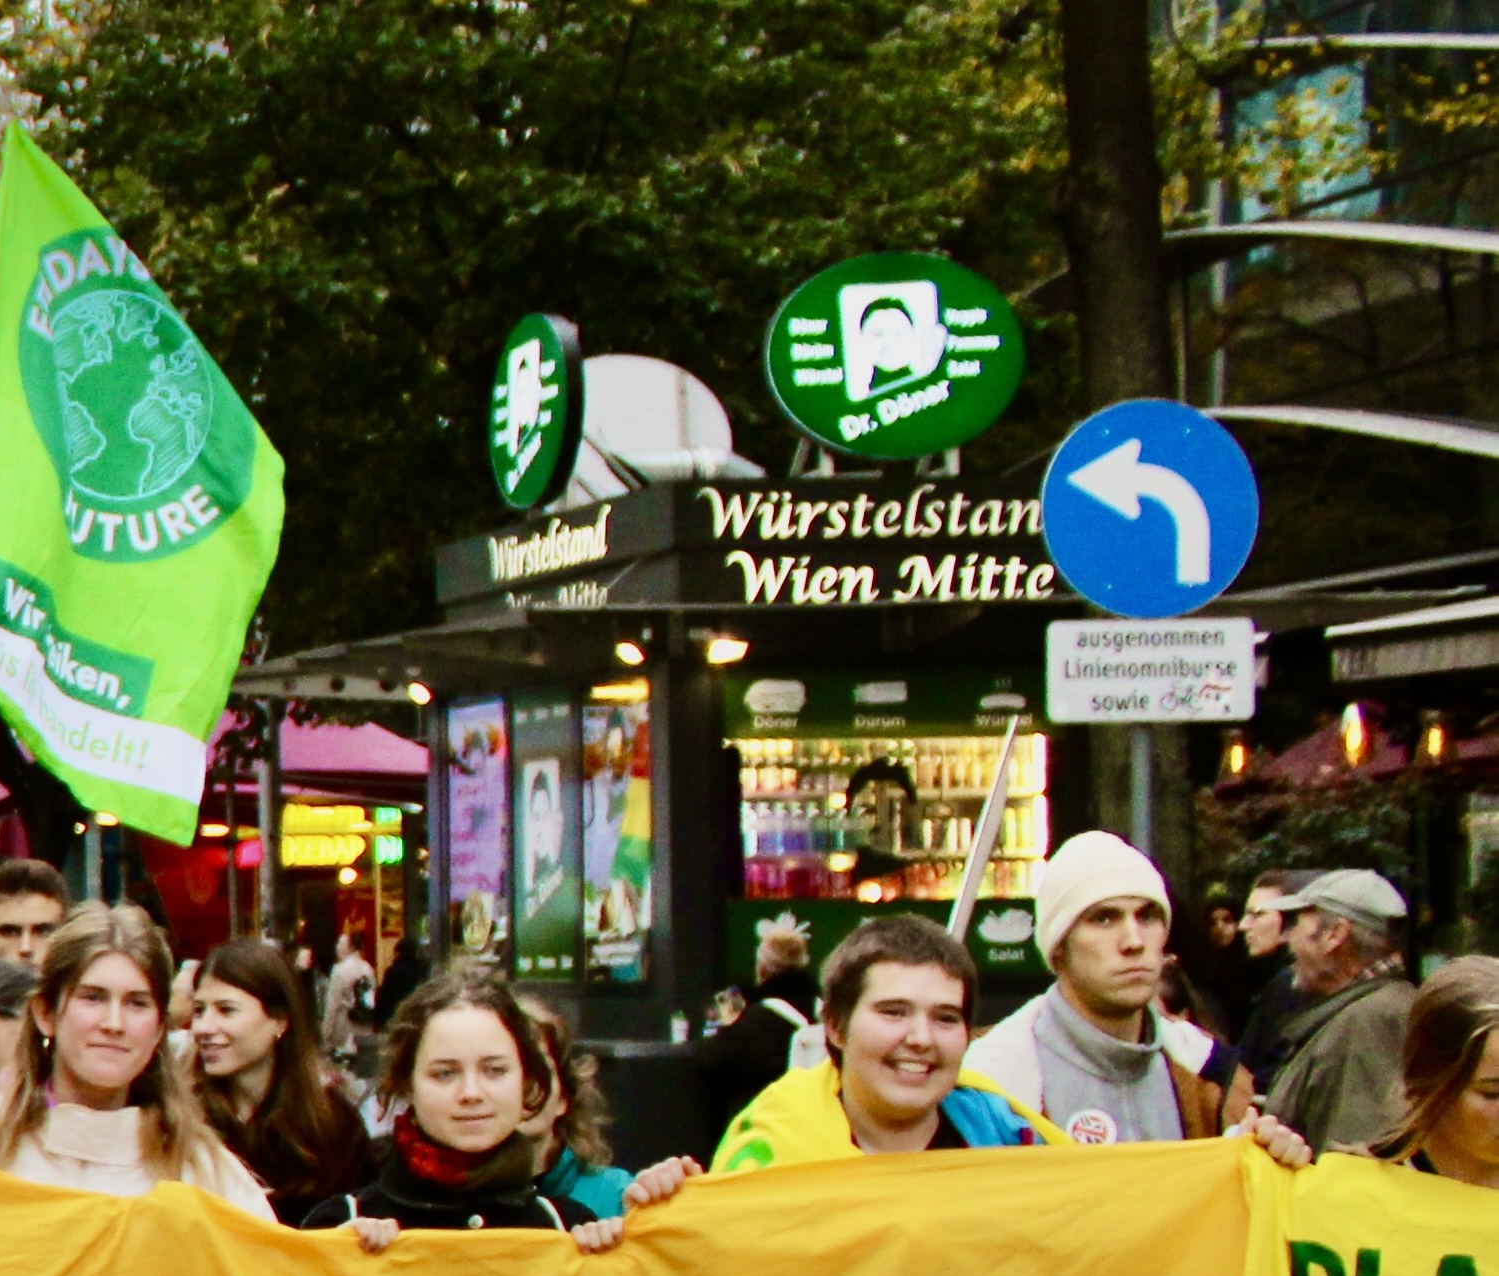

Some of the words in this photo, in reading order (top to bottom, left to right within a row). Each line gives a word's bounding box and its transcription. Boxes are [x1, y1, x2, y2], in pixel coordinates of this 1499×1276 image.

[838, 413, 879, 442] Dr.
[877, 379, 950, 425] Döner
[66, 484, 221, 552] UTURE
[697, 484, 1043, 541] Würstelstan
[489, 504, 612, 582] Würstelstand
[724, 549, 879, 605] Wien
[892, 552, 1054, 604] Mitte
[1076, 629, 1225, 648] ausgenommen
[1091, 692, 1151, 711] sowie
